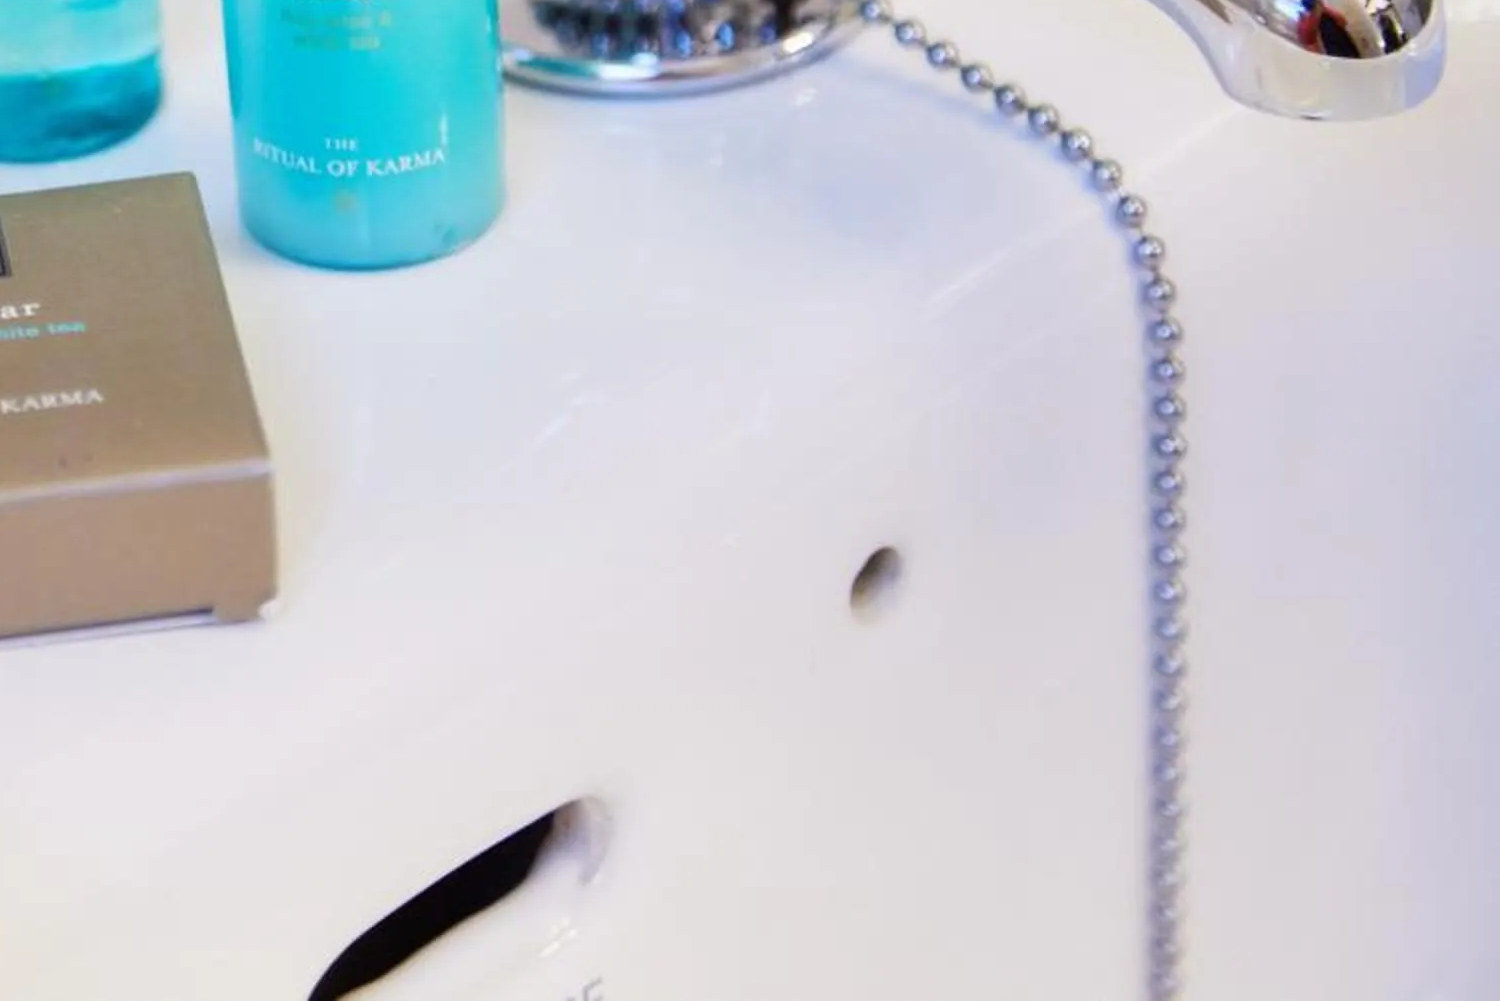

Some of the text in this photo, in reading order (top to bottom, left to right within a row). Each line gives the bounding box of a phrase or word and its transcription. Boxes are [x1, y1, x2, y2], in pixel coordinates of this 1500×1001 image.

[324, 137, 358, 151] THE
[253, 137, 445, 177] RITUAL OF KARMA
[48, 321, 86, 335] tea
[0, 388, 104, 415] KARMA
